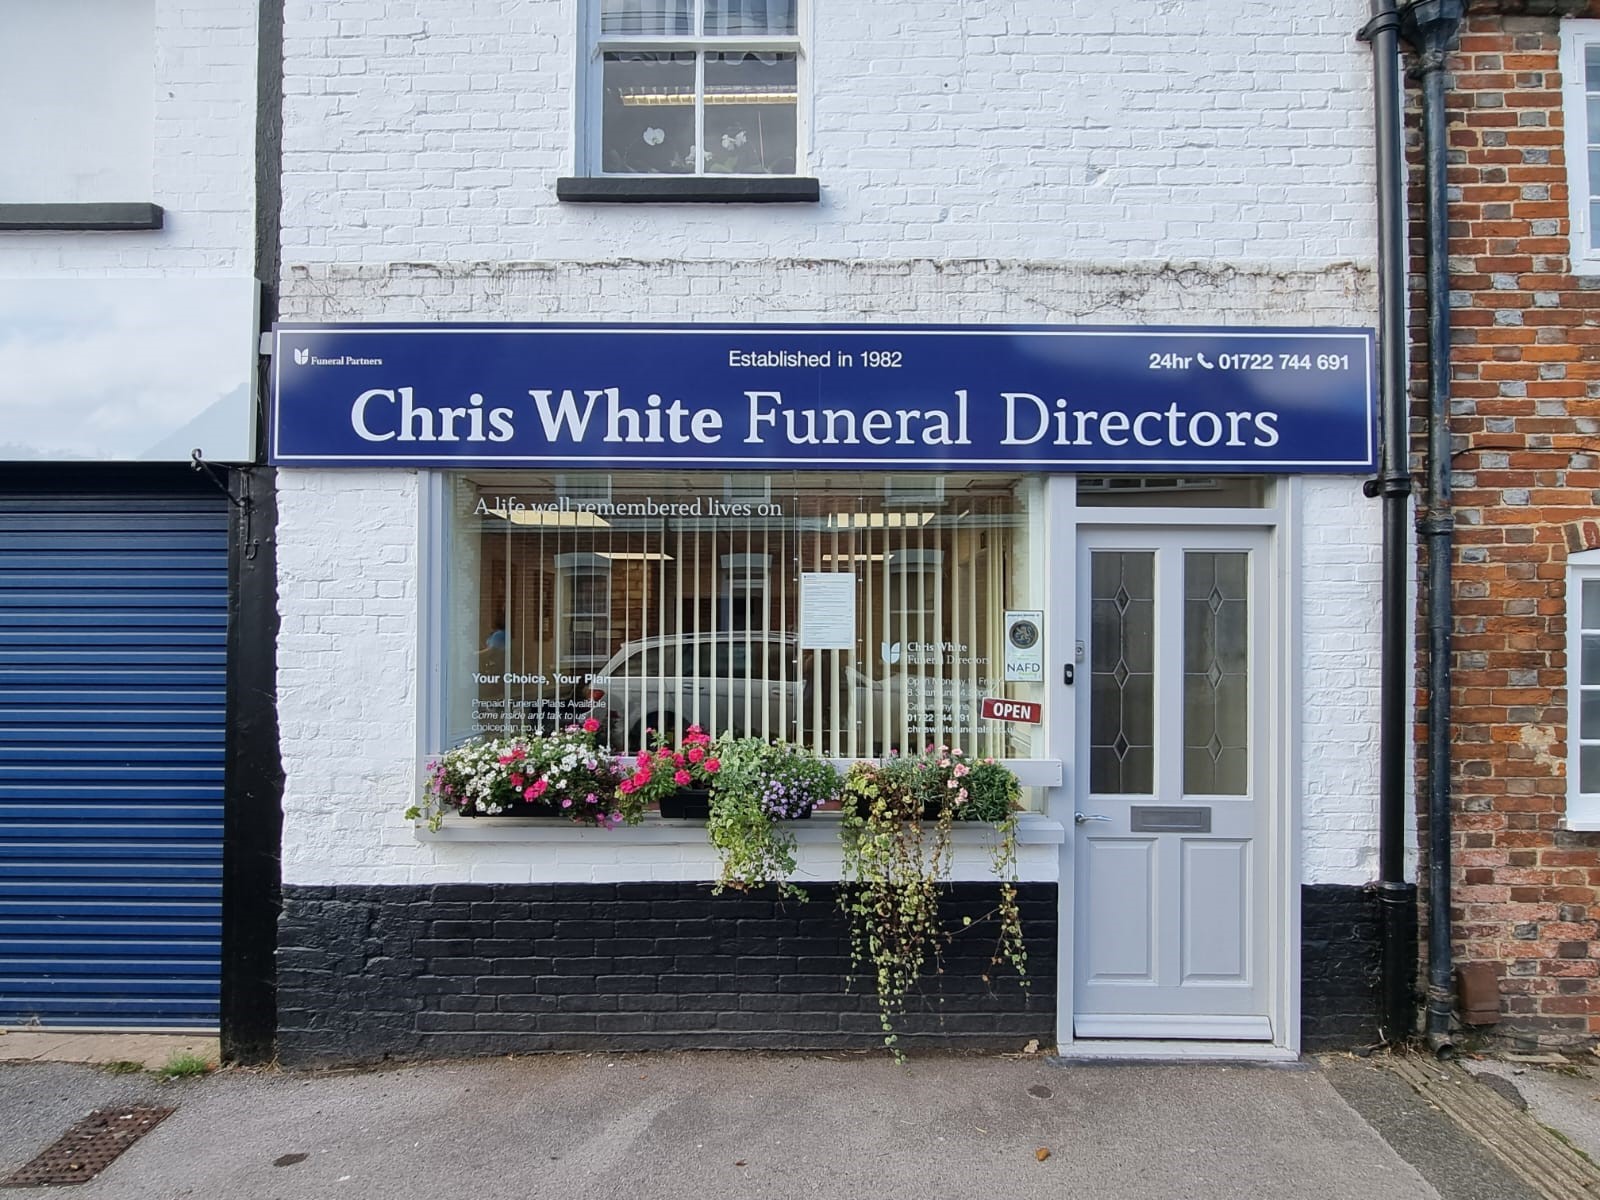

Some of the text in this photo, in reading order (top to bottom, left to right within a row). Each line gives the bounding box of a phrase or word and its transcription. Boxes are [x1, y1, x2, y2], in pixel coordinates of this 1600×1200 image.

[311, 355, 383, 366] Funeral Partners
[728, 351, 903, 368] Established in 1982
[1149, 353, 1349, 370] 24hr 01722 744 691
[351, 386, 1280, 447] Chris White Funeral Directors
[473, 496, 783, 516] A life well remembered lives on
[907, 641, 968, 652] Chris White
[907, 654, 943, 665] Funerl
[1007, 662, 1040, 673] NAFD
[472, 673, 610, 686] Your Choice, Your Plan
[907, 677, 930, 687] Opn
[472, 699, 607, 710] Prepaid Funeral Plans Available
[472, 710, 587, 720] Come inside and talk to us
[993, 702, 1031, 720] OPEN
[954, 713, 970, 722] 91
